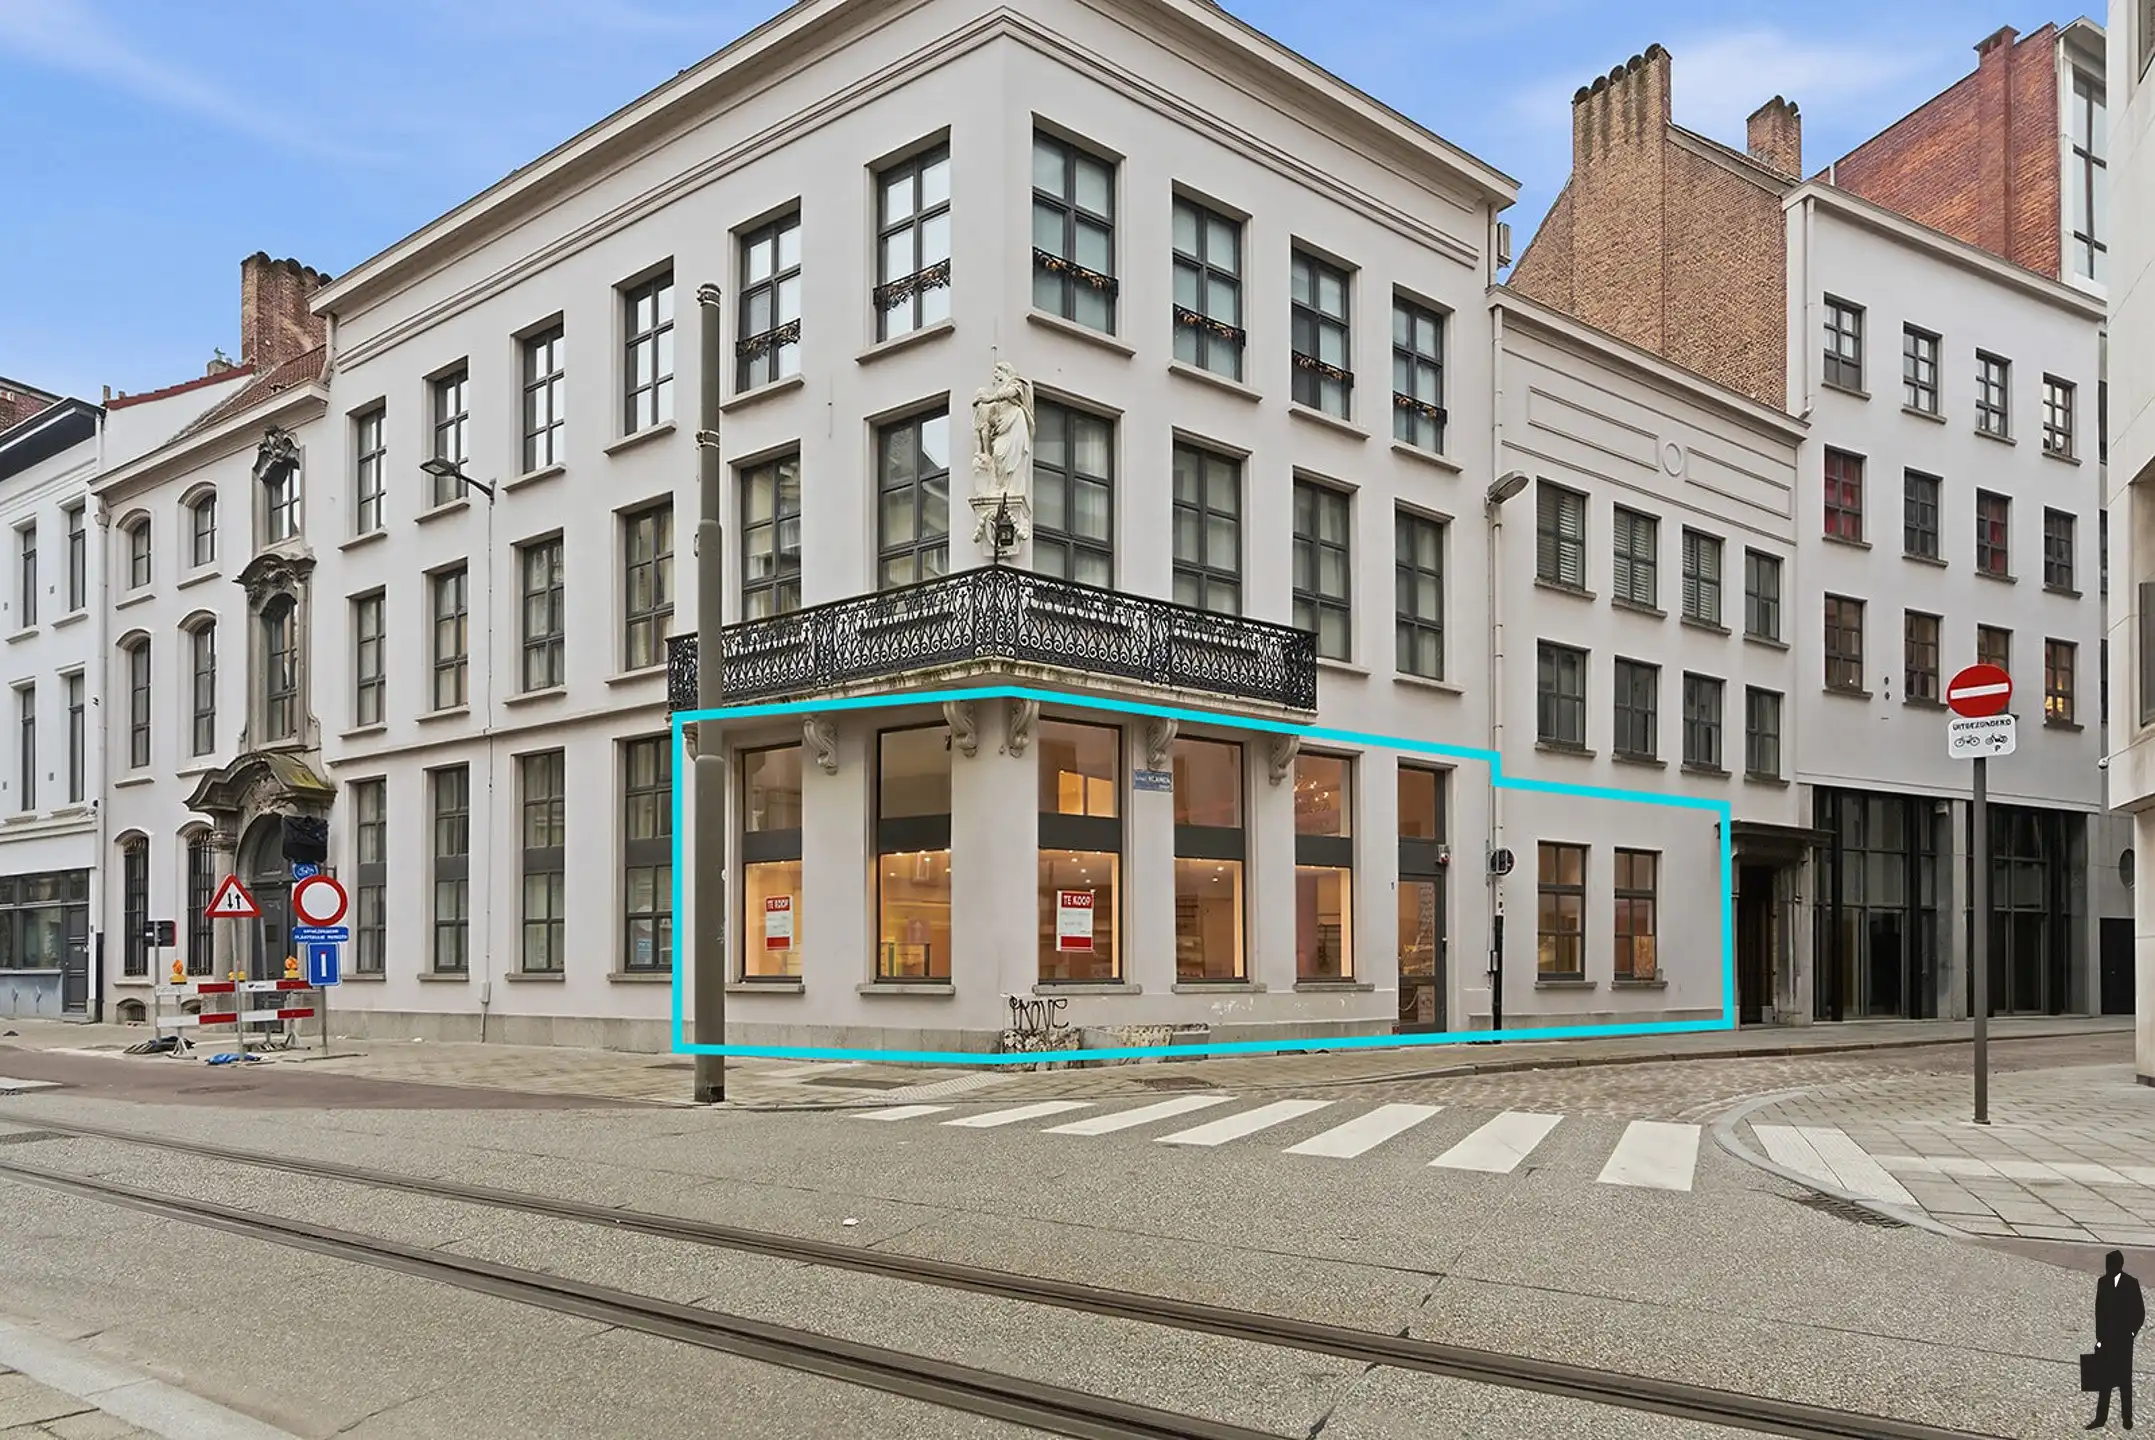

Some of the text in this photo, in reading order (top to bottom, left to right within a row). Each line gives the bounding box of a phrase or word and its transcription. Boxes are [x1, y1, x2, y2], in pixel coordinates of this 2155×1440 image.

[1953, 719, 2011, 731] UITGEZONDERD
[1063, 895, 1091, 906] TE KOOP
